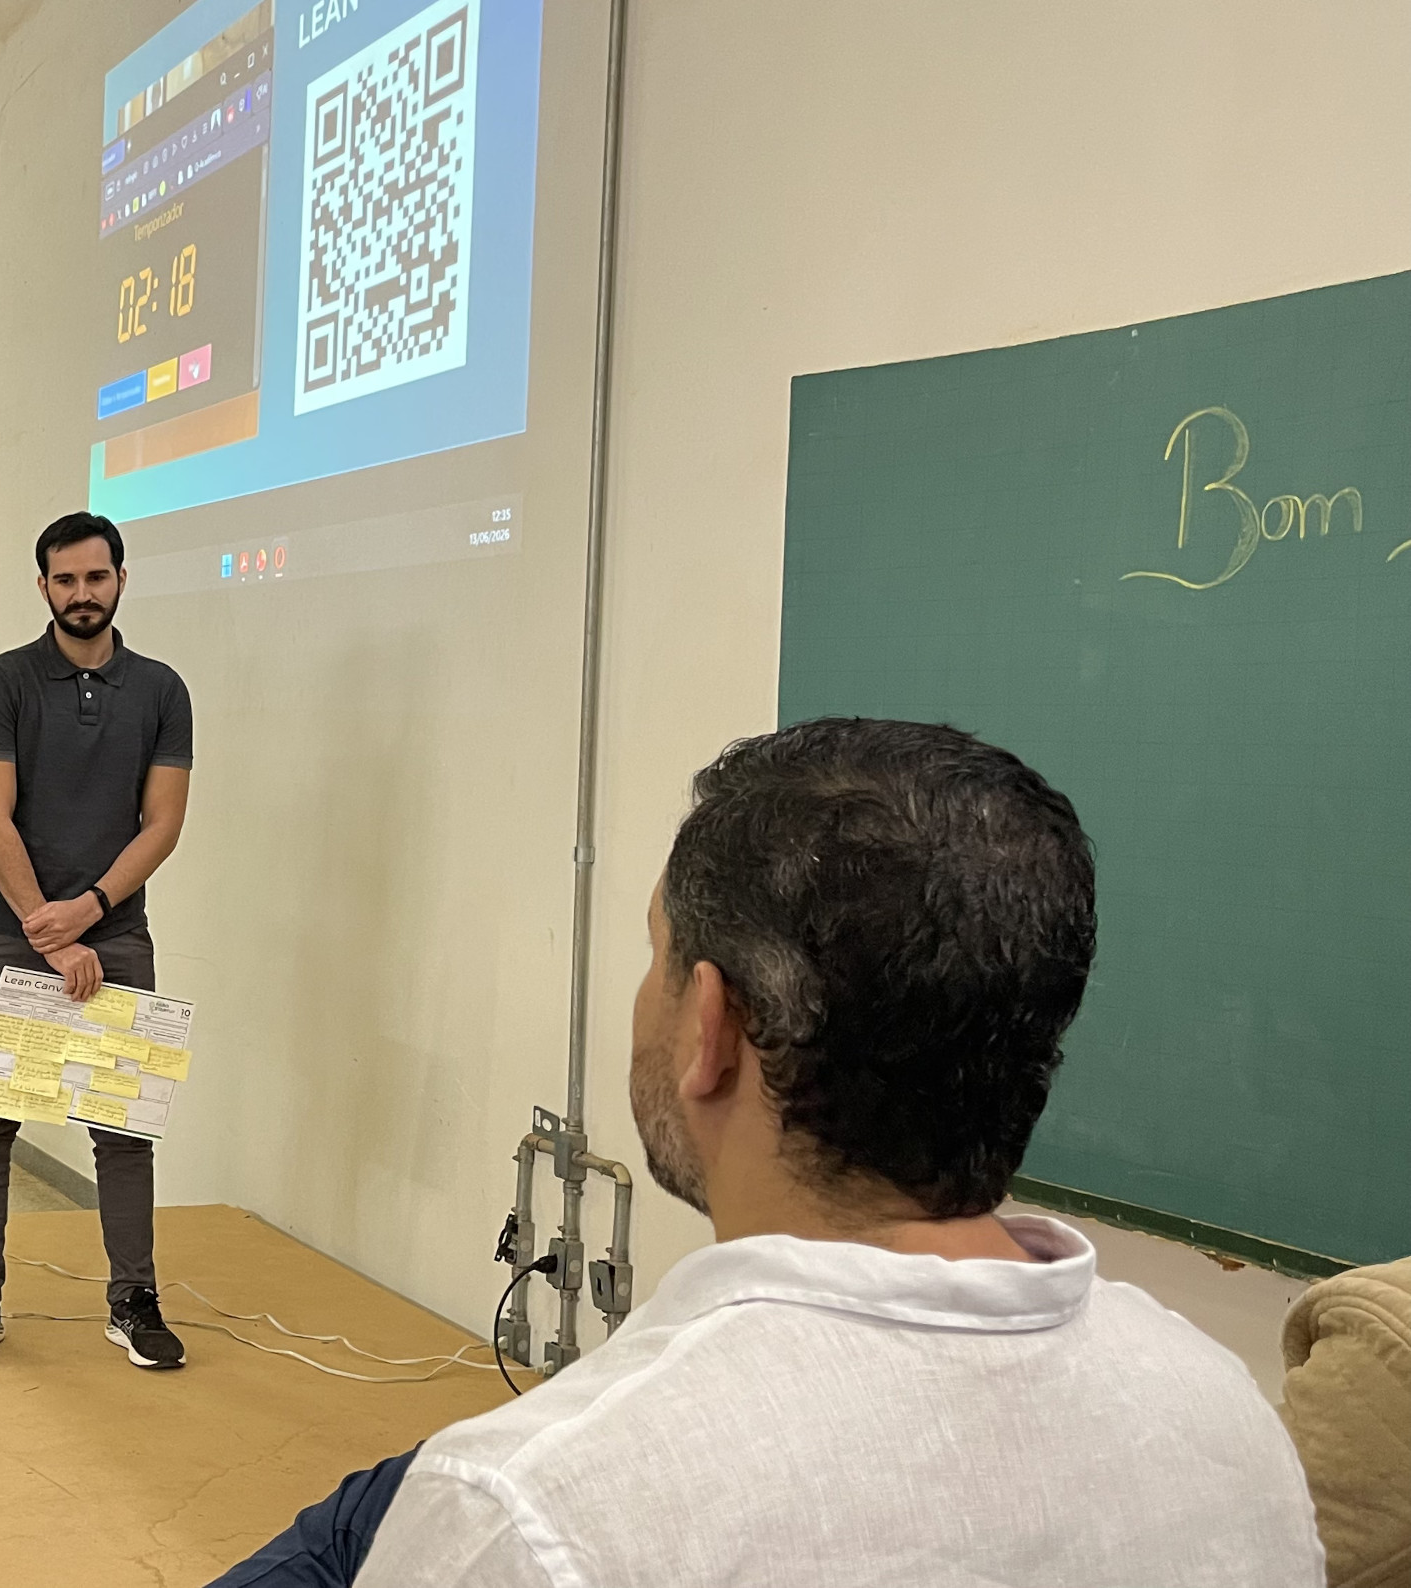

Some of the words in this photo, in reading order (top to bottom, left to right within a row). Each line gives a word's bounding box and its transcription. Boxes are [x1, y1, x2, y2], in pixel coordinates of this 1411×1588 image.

[134, 202, 185, 242] Temporizador
[118, 244, 196, 344] 02:18
[1119, 407, 1362, 590] Bom
[492, 508, 511, 522] 12:35
[4, 975, 32, 987] Lean
[34, 981, 64, 993] Canv
[181, 1009, 191, 1017] 10
